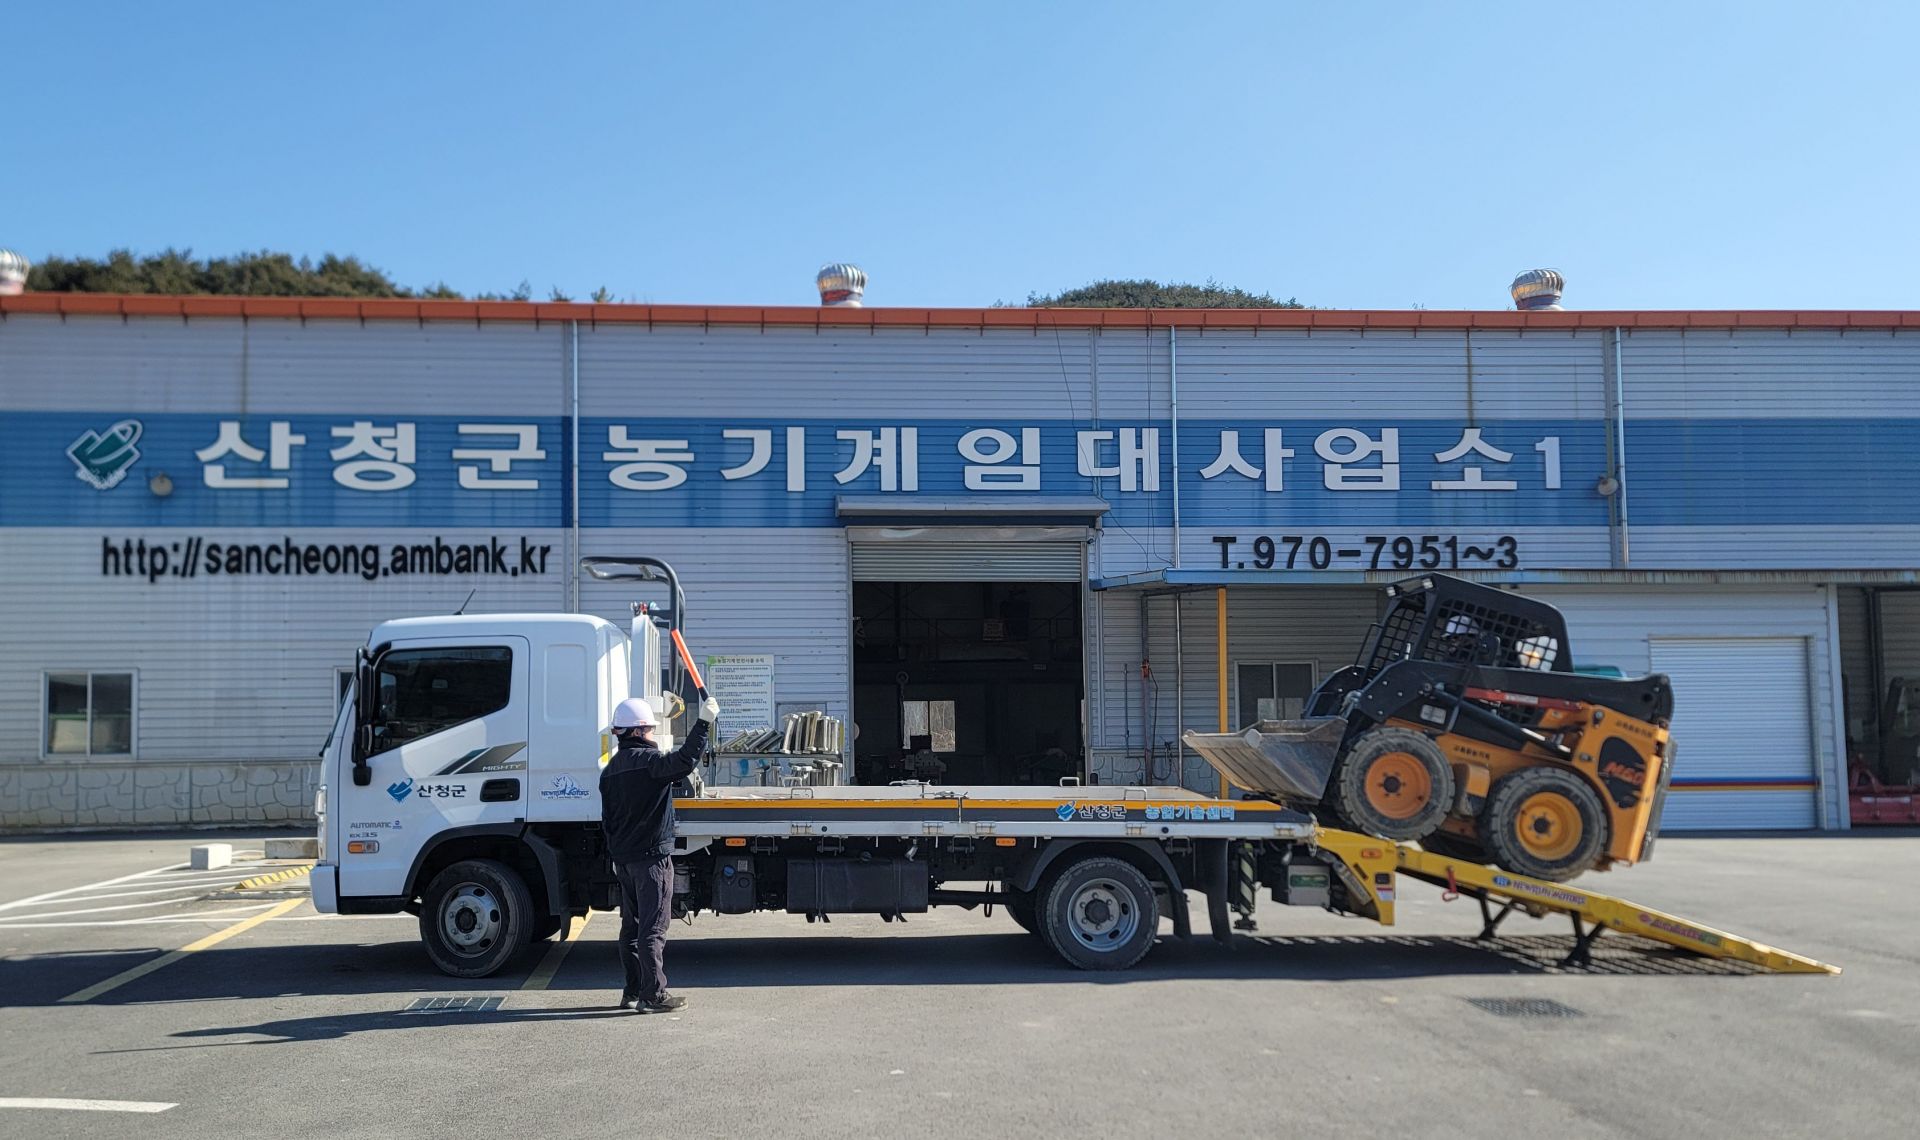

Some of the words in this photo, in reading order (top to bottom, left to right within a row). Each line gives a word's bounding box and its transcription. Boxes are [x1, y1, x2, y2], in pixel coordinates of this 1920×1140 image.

[195, 420, 547, 492] 산청군
[101, 536, 551, 583] http://sancheong.ambank.kr
[1212, 535, 1520, 570] T.970-7951~3
[482, 763, 522, 771] MIGHTY
[417, 784, 466, 798] 산청군
[1079, 804, 1127, 820] 산청군
[1145, 805, 1235, 820] 농업기술센터
